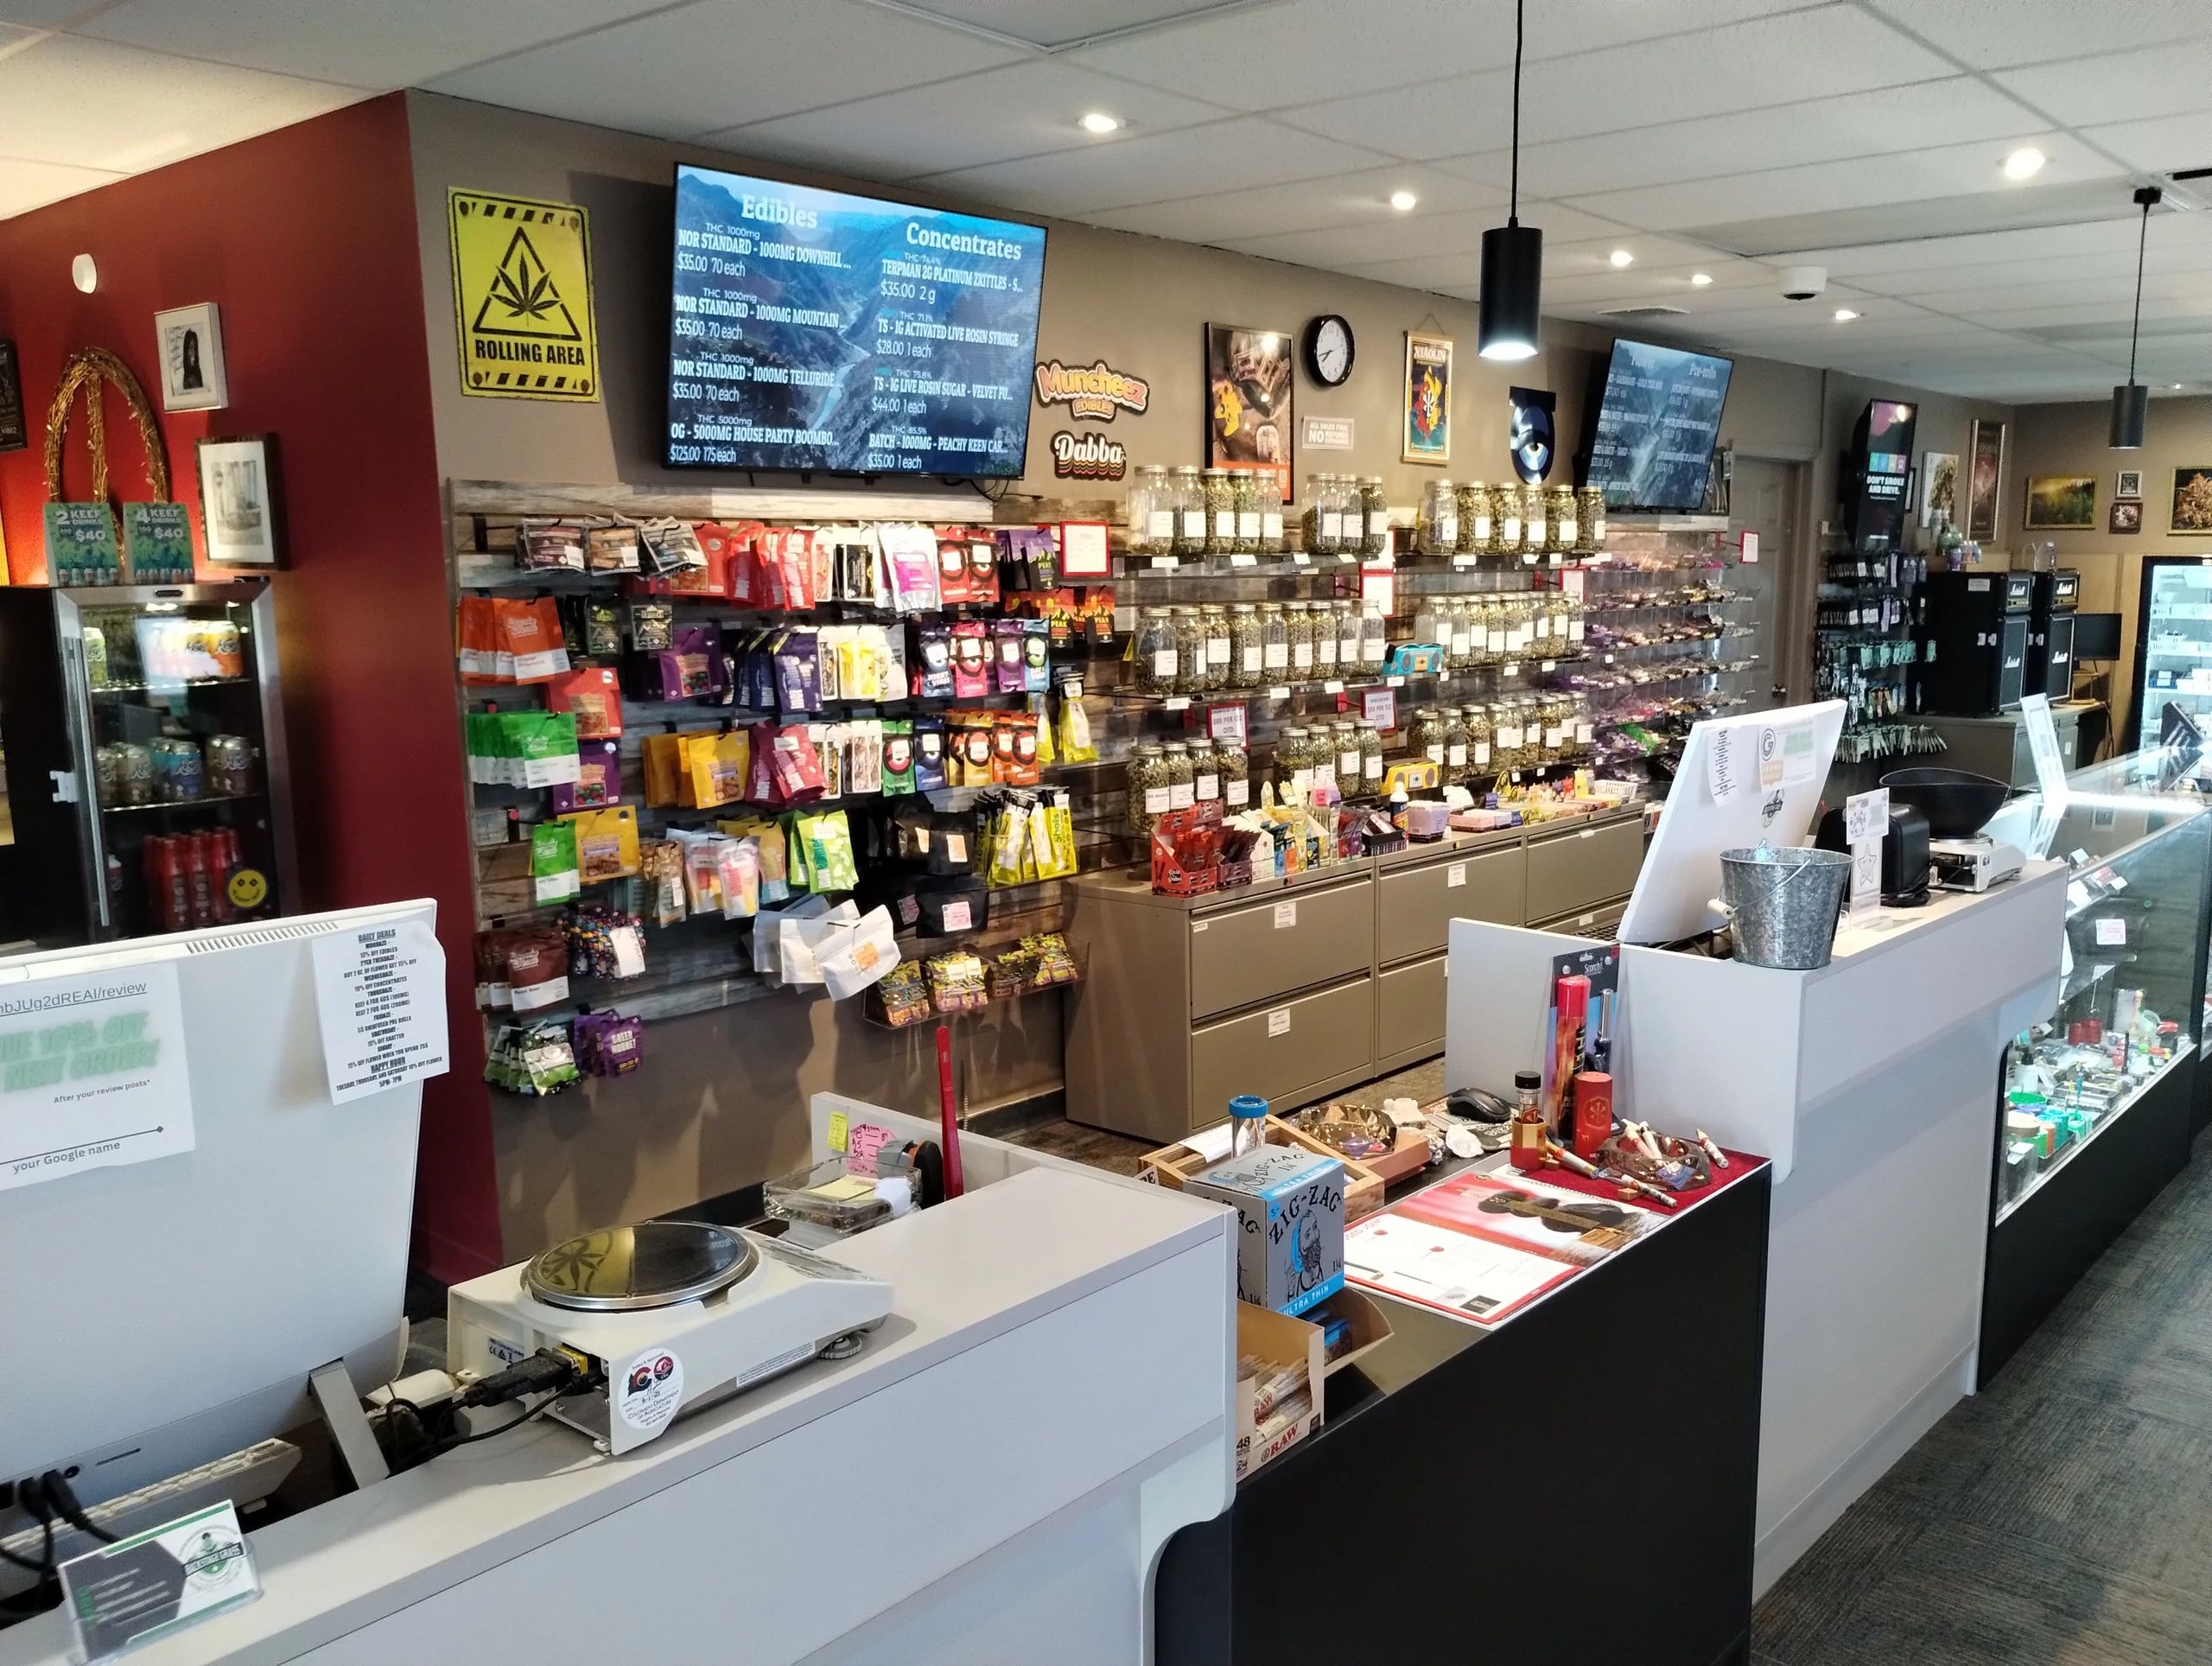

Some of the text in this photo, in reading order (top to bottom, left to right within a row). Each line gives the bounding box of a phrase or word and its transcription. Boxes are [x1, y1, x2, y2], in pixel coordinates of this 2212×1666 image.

[741, 194, 817, 228] Edibles
[705, 223, 760, 240] THC 1000mg
[678, 230, 795, 261] NOR STANDARD 1000MG
[907, 222, 1022, 260] Concentrates
[677, 253, 745, 277] $35.00 70 each
[882, 260, 921, 278] TERPMAN
[933, 268, 973, 285] PLATINUM
[703, 288, 757, 303] THC 1000mg
[880, 280, 935, 304] $35.00 2 g
[675, 296, 791, 323] NOR STANDARD 1000MG
[675, 319, 742, 340] $35.00 70 each
[878, 319, 1019, 347] TS ACTIVATED LIVE ROSIN SYRINGE
[475, 339, 584, 366] ROLLING AREA
[876, 340, 931, 358] $28.00 each
[1414, 347, 1446, 363] XIAOLIN
[700, 352, 754, 366] THC 1000mg
[674, 359, 788, 385] NOR STANDARD 1000MG
[896, 369, 910, 378] THC
[672, 382, 740, 402] $35.00 70 each
[874, 377, 998, 399] TS LIVE ROSIN SUGAR VELVET
[1038, 364, 1147, 410] Muncheez
[872, 397, 926, 415] $44.00 each
[698, 415, 752, 427] THC 5000mg
[892, 425, 905, 434] THC
[671, 423, 794, 444] OG 5000MG HOUSE PARTY
[1309, 430, 1324, 442] NO
[869, 434, 988, 452] BATCH 1000MG PEACHY KEEN
[1055, 435, 1126, 467] Dabba
[715, 448, 736, 463] each
[868, 454, 922, 469] $35.00 each
[1885, 477, 1904, 486] SMOKE
[55, 510, 101, 525] 2 KEEF
[136, 508, 181, 523] 4 KEEF
[75, 529, 105, 543] $40
[155, 527, 183, 539] $40
[359, 929, 396, 942] DAILY DEALS
[374, 976, 407, 988] CONCENTRATES
[385, 1033, 404, 1041] SHATTER
[365, 1054, 381, 1064] FLOWER
[371, 1057, 405, 1073] HAPPY HOUR
[388, 1065, 407, 1076] SATURDAY
[76, 1091, 94, 1100] your
[97, 1085, 124, 1095] review
[12, 1142, 120, 1174] your Google name
[1255, 1154, 1304, 1176] ZIG-ZAG
[1269, 1185, 1341, 1244] ZIG-ZAG
[1282, 1285, 1329, 1316] ULTRA THIN
[628, 1404, 652, 1419] COLORADO
[1254, 1392, 1272, 1418] RAW
[1236, 1436, 1250, 1449] 48
[1270, 1423, 1299, 1457] RAW
